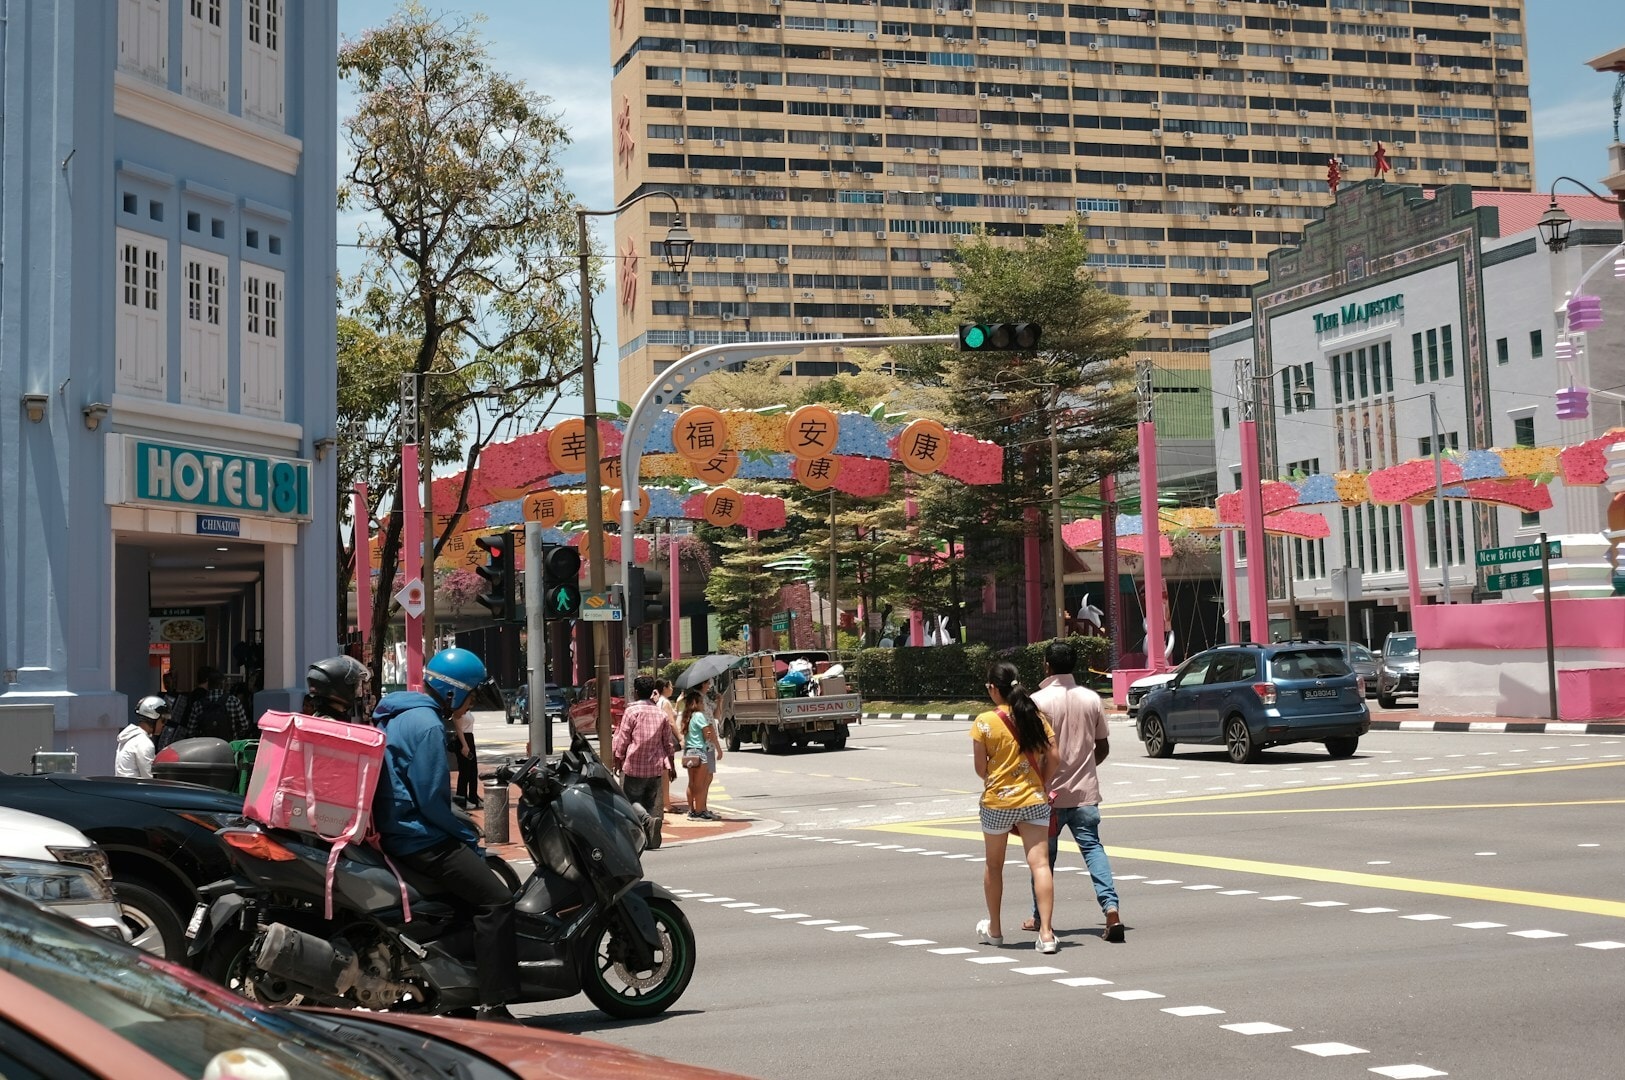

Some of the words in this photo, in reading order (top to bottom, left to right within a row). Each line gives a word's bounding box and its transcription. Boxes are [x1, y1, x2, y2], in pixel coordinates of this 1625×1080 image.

[685, 421, 715, 450] 福
[798, 419, 828, 448] 安
[910, 432, 939, 461] 康
[148, 447, 263, 508] HOTEL
[271, 462, 309, 515] 81
[533, 499, 556, 521] 福
[711, 498, 736, 517] 康
[201, 518, 241, 533] CHINATOWN
[447, 534, 465, 552] 福
[1480, 551, 1497, 562] New
[1499, 548, 1527, 561] Bridge
[1529, 545, 1540, 557] Rd
[796, 702, 844, 713] NISSAN
